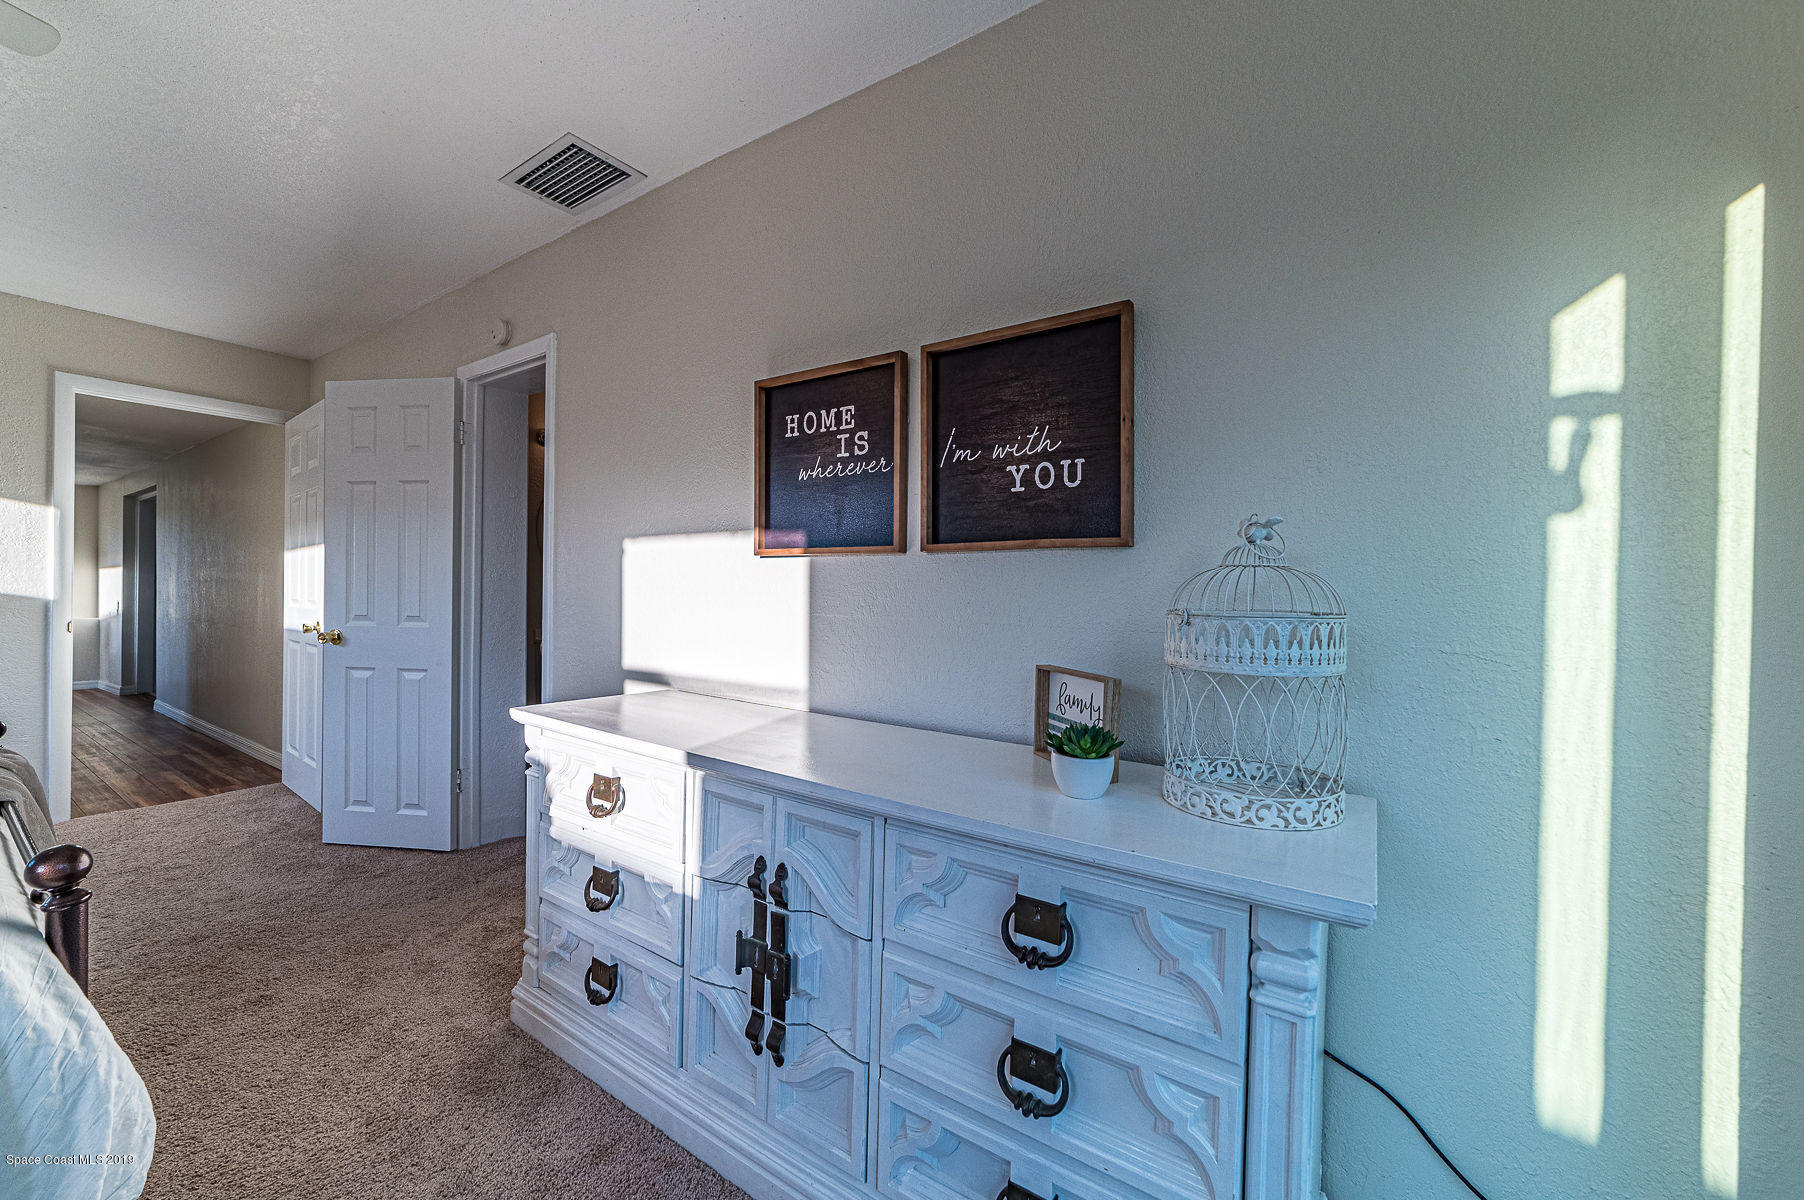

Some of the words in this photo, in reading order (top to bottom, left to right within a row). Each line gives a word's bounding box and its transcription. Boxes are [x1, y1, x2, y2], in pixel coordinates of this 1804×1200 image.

[785, 405, 855, 438] HOME
[836, 430, 869, 458] IS
[992, 425, 1062, 459] with
[798, 456, 894, 481] wherever
[1006, 458, 1085, 492] YOU
[1056, 681, 1103, 727] family
